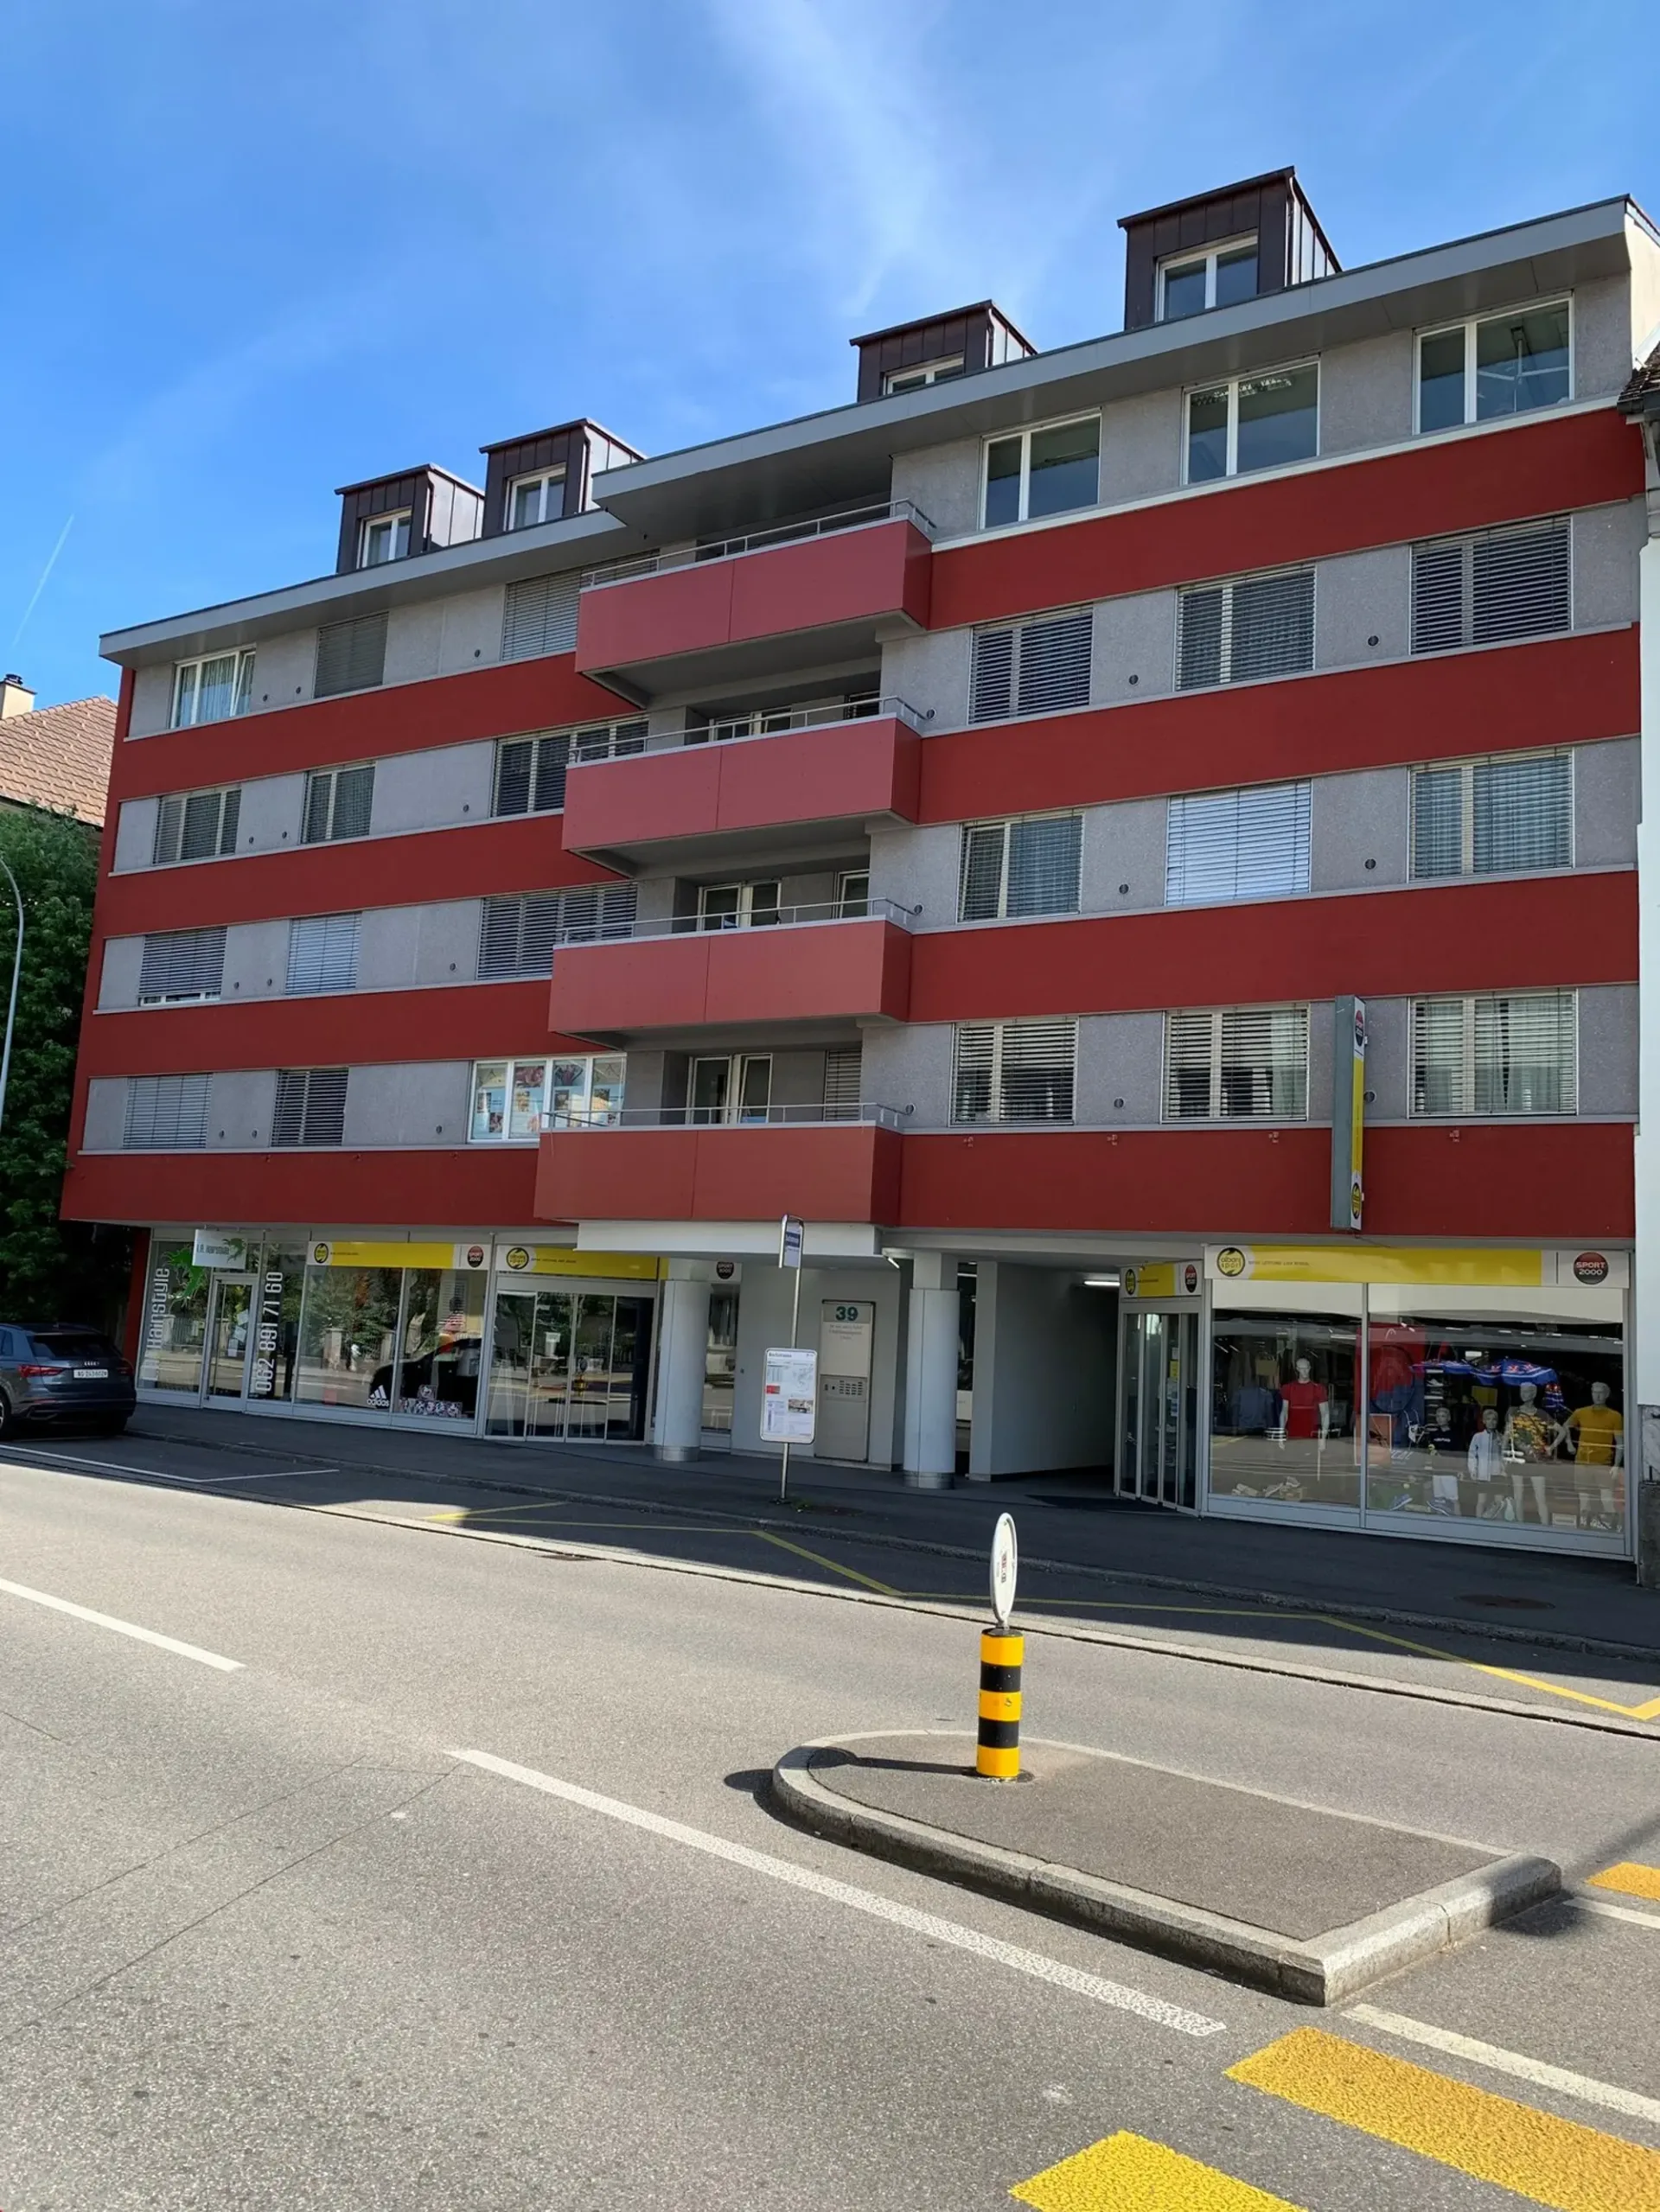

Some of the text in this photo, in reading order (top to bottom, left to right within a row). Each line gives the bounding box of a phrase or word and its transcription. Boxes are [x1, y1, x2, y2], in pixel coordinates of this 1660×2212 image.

[145, 1267, 170, 1349] Hairstyle
[255, 1272, 284, 1392] 062 891 71 60
[835, 1305, 859, 1322] 39
[367, 1398, 390, 1407] adidas
